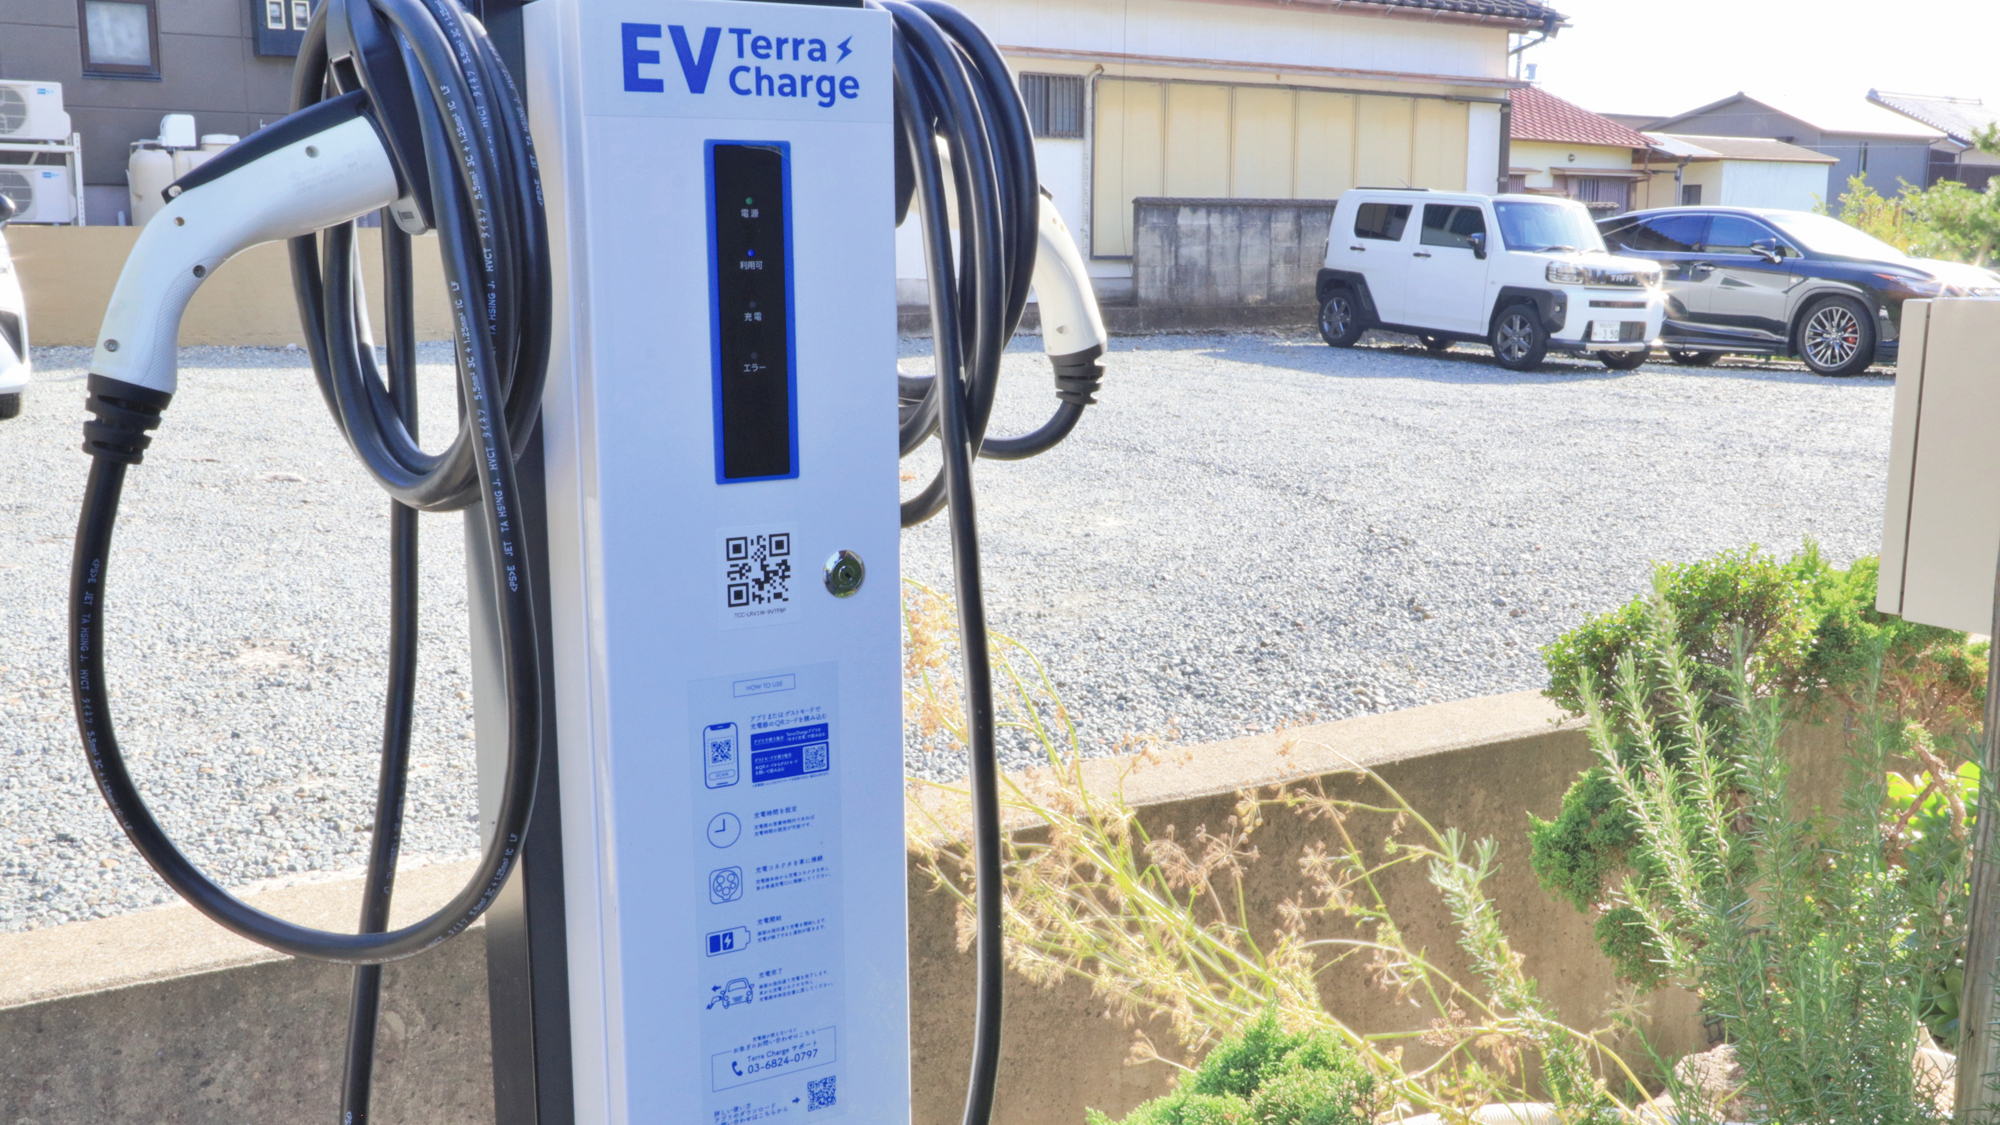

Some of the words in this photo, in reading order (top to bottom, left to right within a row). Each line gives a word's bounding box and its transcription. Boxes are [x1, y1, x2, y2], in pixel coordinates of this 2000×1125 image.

[728, 28, 827, 62] Terra
[621, 22, 722, 94] EV
[440, 85, 450, 95] LF
[729, 66, 860, 108] Charge
[477, 106, 488, 128] HVCT
[526, 136, 532, 146] TA
[466, 155, 475, 167] 3C
[530, 155, 538, 170] JET
[741, 209, 759, 218] 電源
[483, 248, 494, 272] HVCT
[740, 261, 763, 270] 利用可
[451, 281, 459, 291] LF
[488, 281, 494, 289] J.
[488, 293, 496, 320] HSING
[744, 312, 762, 321] 充電
[467, 357, 475, 368] 3C
[744, 364, 766, 372] エラー
[486, 447, 497, 470] HVCT
[494, 491, 507, 518] HSING
[500, 521, 509, 532] TA
[503, 541, 513, 556] JET
[84, 591, 93, 605] JET
[82, 613, 91, 623] TA
[80, 627, 89, 651] HSING
[80, 670, 89, 690] HVCT
[123, 821, 133, 831] LF
[510, 833, 518, 842] LF
[747, 1054, 765, 1062] Terra
[766, 1048, 789, 1059] Charge
[792, 1040, 817, 1052] サポート
[748, 1049, 818, 1074] 03-6824-0797
